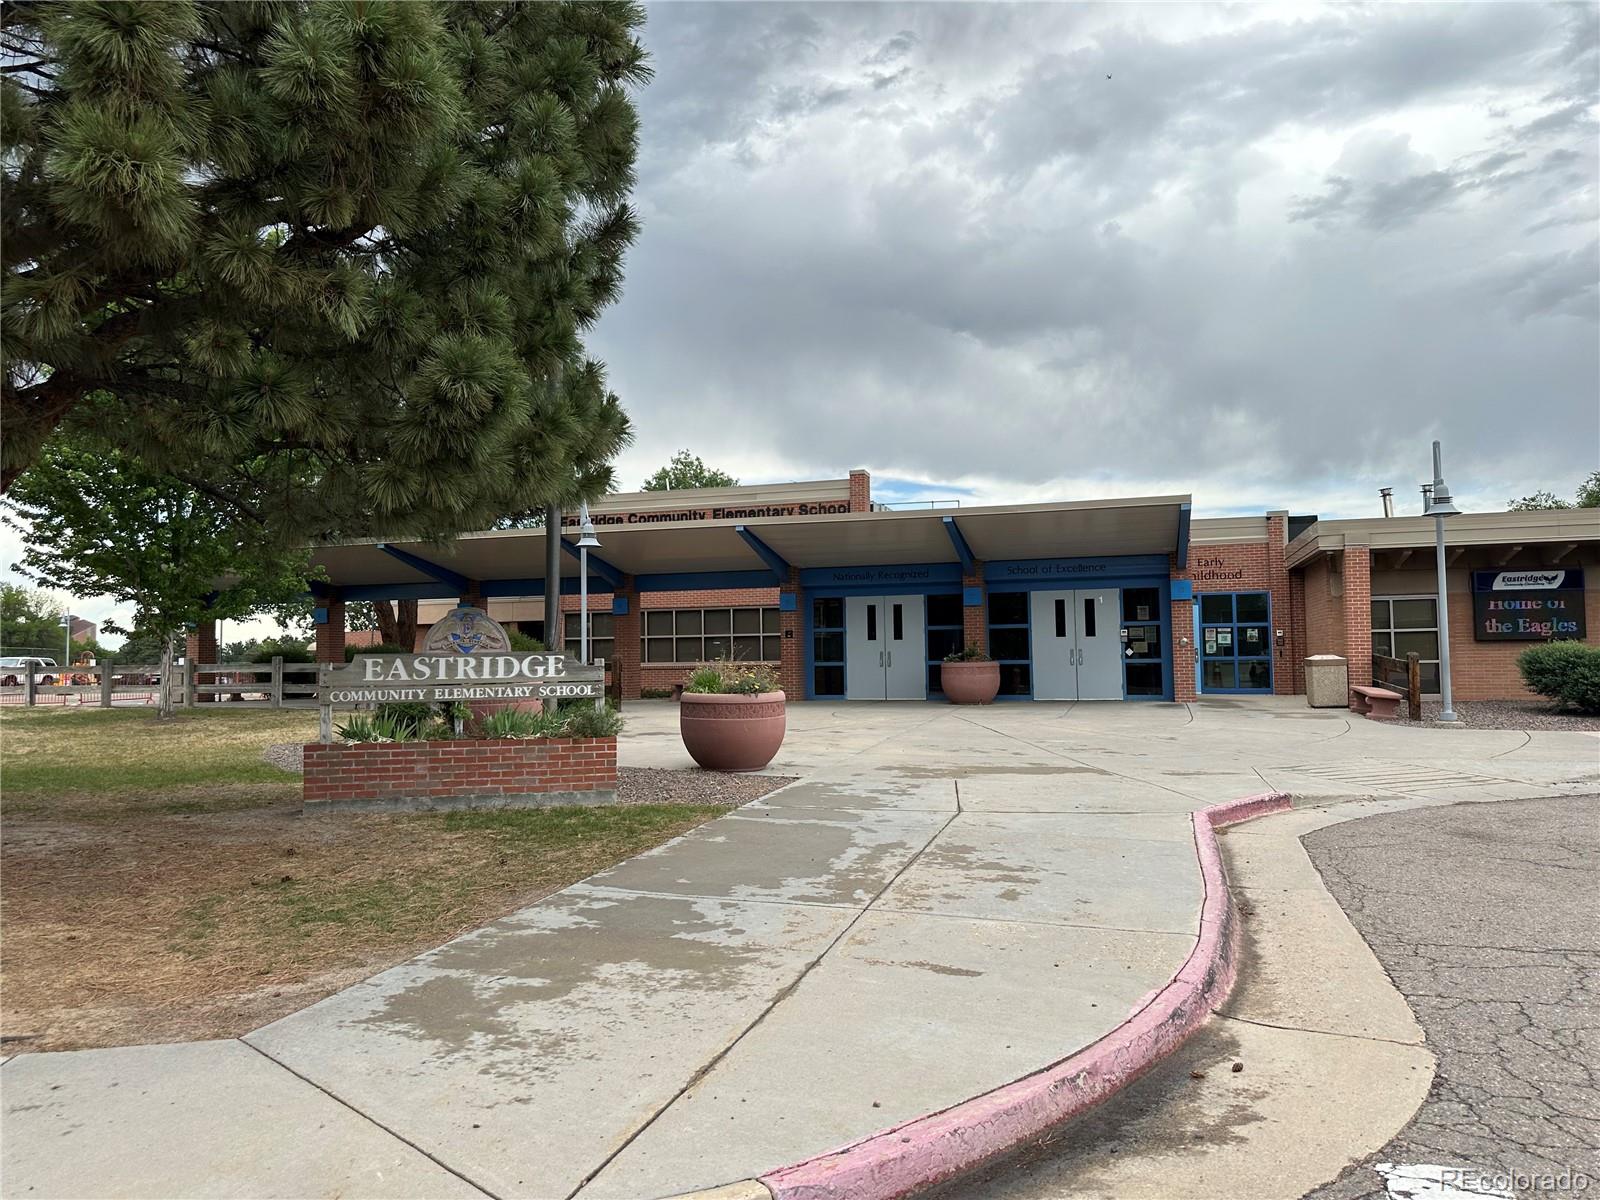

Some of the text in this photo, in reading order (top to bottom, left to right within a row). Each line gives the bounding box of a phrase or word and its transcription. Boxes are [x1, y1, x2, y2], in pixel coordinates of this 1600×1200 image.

[628, 509, 706, 523] Community
[712, 506, 795, 519] Elementary
[799, 500, 851, 515] School
[1007, 563, 1106, 575] School of Excellence
[1197, 557, 1224, 568] Early
[832, 568, 929, 582] Nationally Recognized
[1502, 574, 1545, 583] Eastridge
[1485, 617, 1578, 636] the Eagles
[363, 654, 566, 681] EASTRIDGE
[330, 684, 595, 703] COMMUNITY ELEMENTARY SCHOOL
